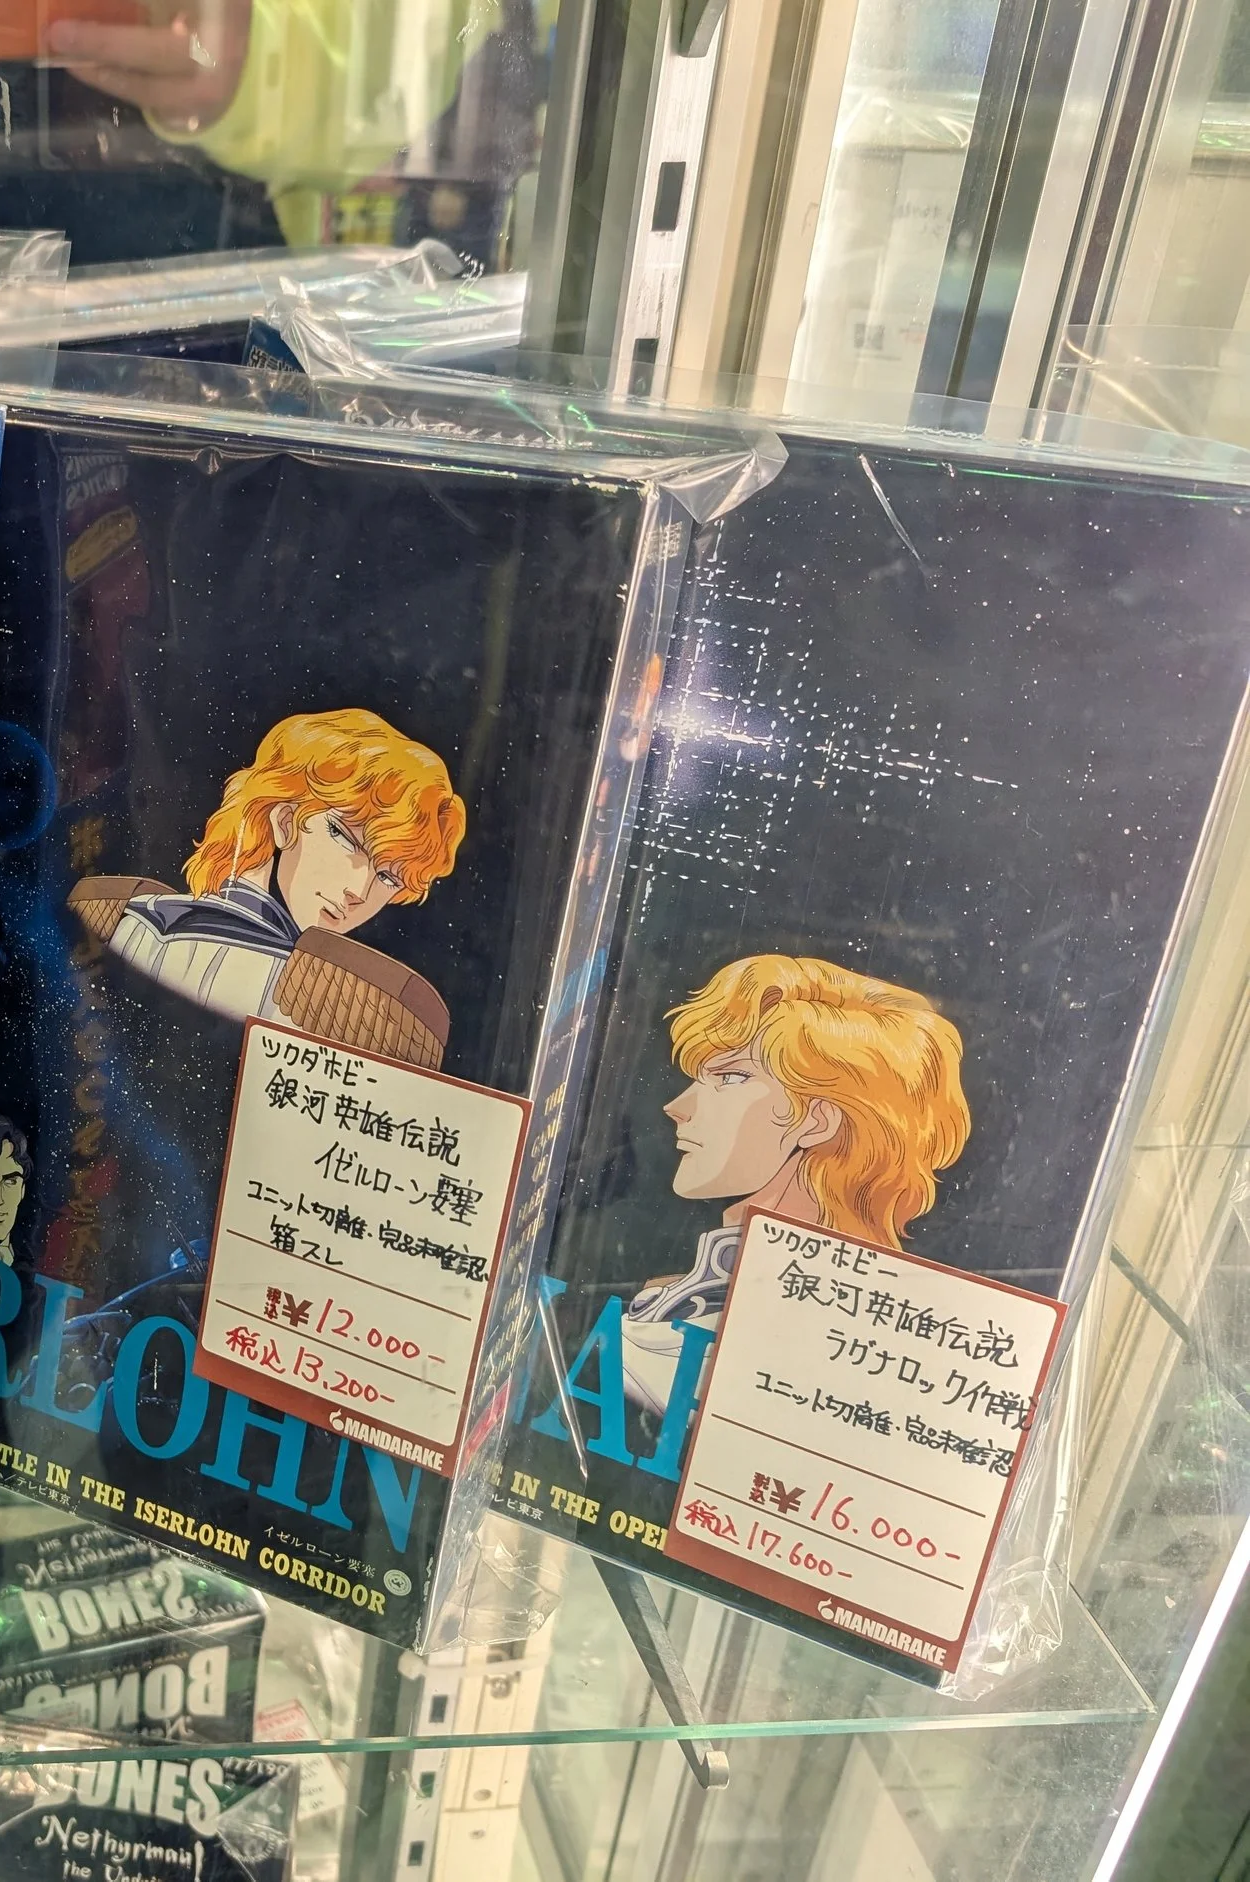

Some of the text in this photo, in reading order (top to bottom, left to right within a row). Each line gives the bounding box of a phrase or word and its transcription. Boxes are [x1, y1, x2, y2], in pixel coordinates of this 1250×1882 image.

[262, 1036, 378, 1086] ツクダホビー
[264, 1068, 461, 1167] 銀河英雄伝説
[314, 1141, 483, 1227] イゼルローン要塞
[763, 1223, 898, 1279] ツクダホビー
[777, 1259, 1019, 1369] 銀河英雄伝説
[826, 1328, 1039, 1432] ラグナロック作戦
[343, 1416, 445, 1472] MANDARAKE
[510, 1470, 541, 1500] IN
[550, 1485, 601, 1525] THE
[46, 1462, 72, 1490] IN
[81, 1476, 126, 1512] THE
[134, 1497, 250, 1561] ISERLOHN
[259, 1547, 386, 1615] CORRIDOR
[263, 1525, 377, 1578] イゼルローン要塞
[833, 1607, 947, 1667] MANDARAKE
[63, 1857, 93, 1880] the
